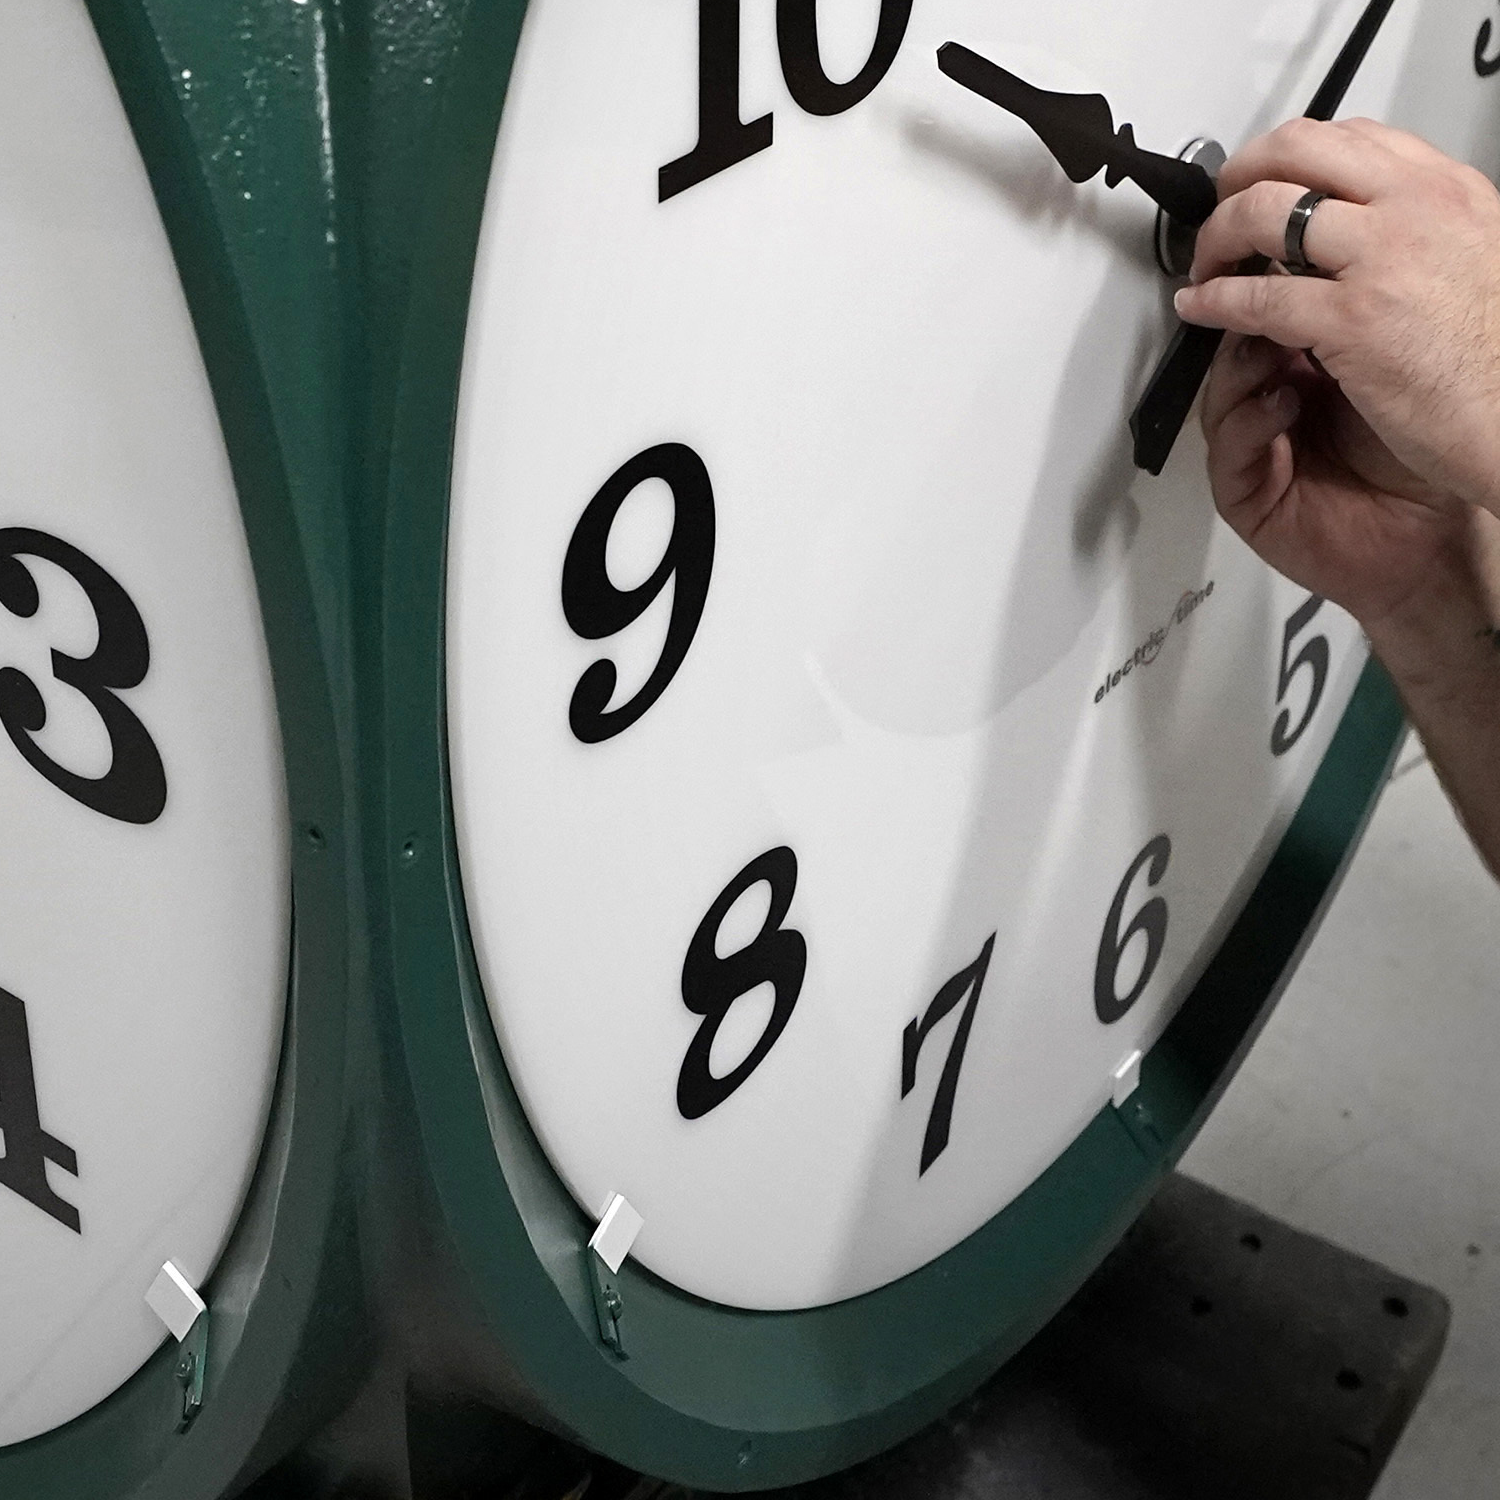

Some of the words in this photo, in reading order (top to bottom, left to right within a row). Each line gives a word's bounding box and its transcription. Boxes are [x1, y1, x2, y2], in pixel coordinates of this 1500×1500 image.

[561, 443, 715, 744] 9
[1270, 595, 1330, 757] 5
[677, 846, 807, 1120] 8
[1094, 833, 1172, 1025] 6
[901, 932, 996, 1178] 7
